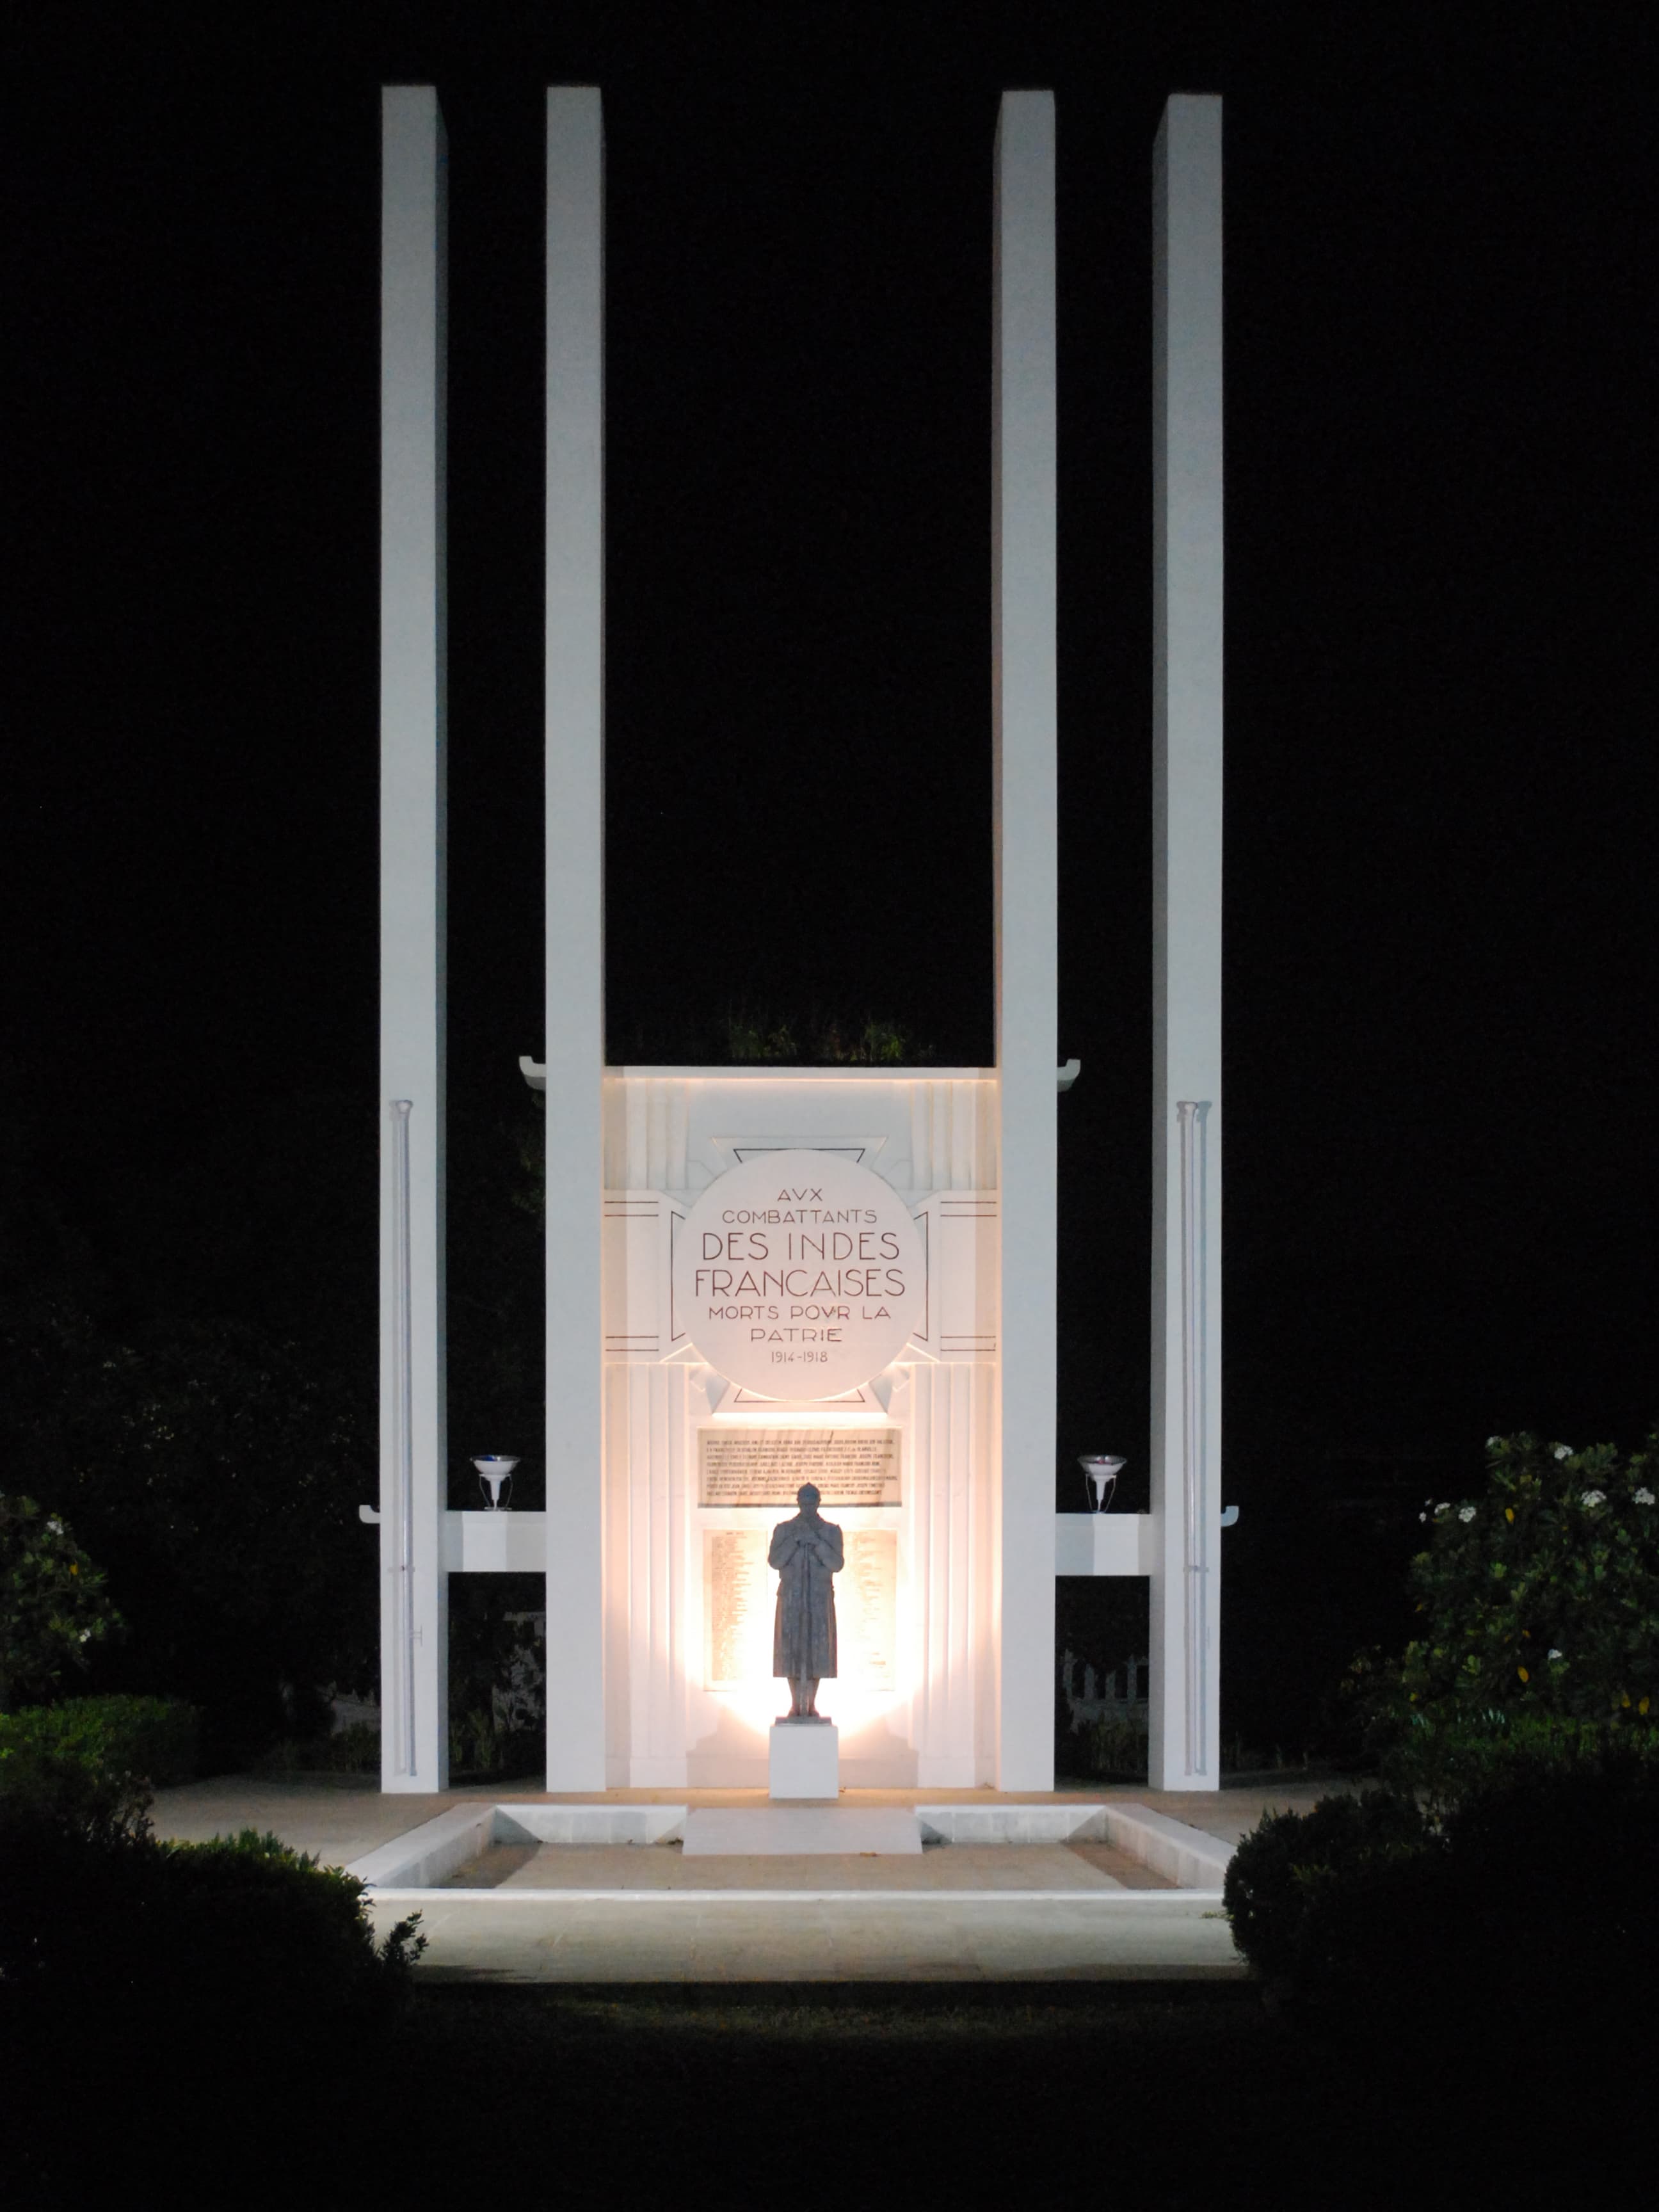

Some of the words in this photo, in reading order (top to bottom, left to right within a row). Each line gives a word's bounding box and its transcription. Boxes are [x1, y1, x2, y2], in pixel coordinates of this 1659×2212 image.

[776, 1187, 823, 1202] AVX
[721, 1208, 878, 1224] COMBATTANTS
[702, 1231, 769, 1261] DES
[788, 1231, 900, 1261] INDES
[695, 1268, 906, 1297] FRANCAISES
[709, 1305, 780, 1320] MORTS
[862, 1305, 892, 1320] LA
[750, 1327, 843, 1343] PATRIE
[771, 1350, 828, 1364] 1914-1918
